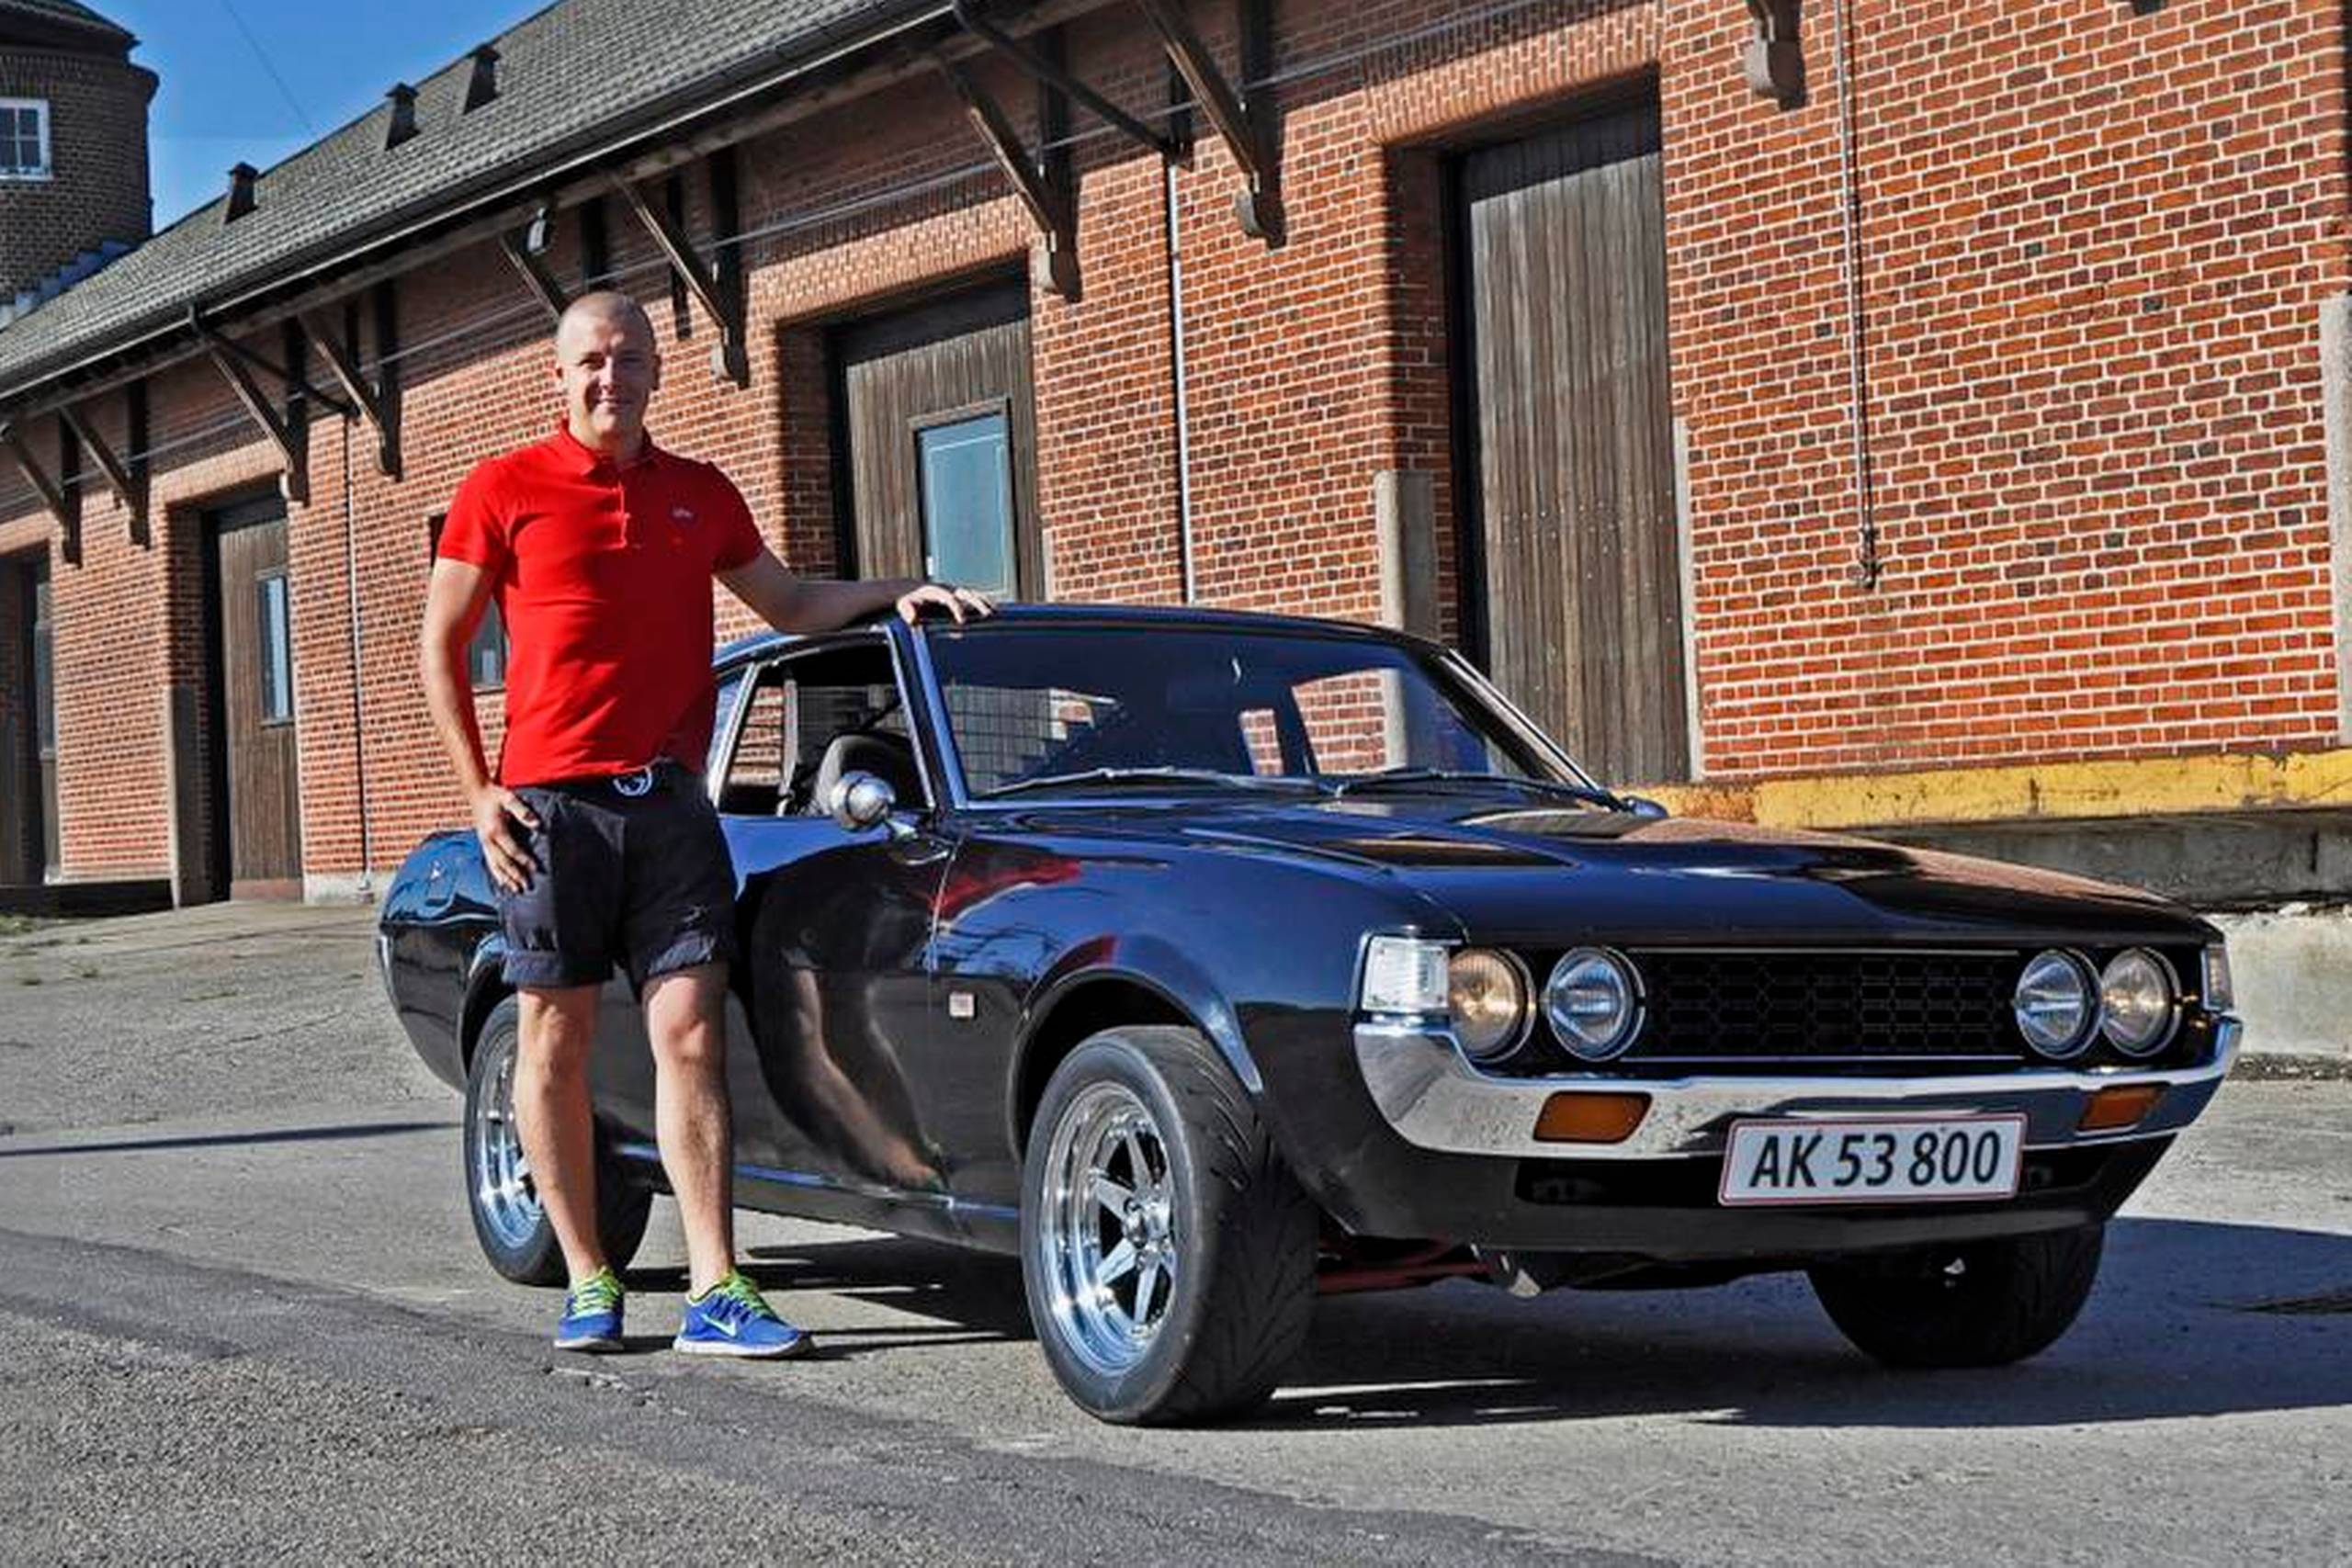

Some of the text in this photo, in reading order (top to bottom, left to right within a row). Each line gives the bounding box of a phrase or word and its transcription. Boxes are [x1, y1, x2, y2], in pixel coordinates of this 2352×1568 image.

[1748, 1130, 2001, 1188] AK 53 800
